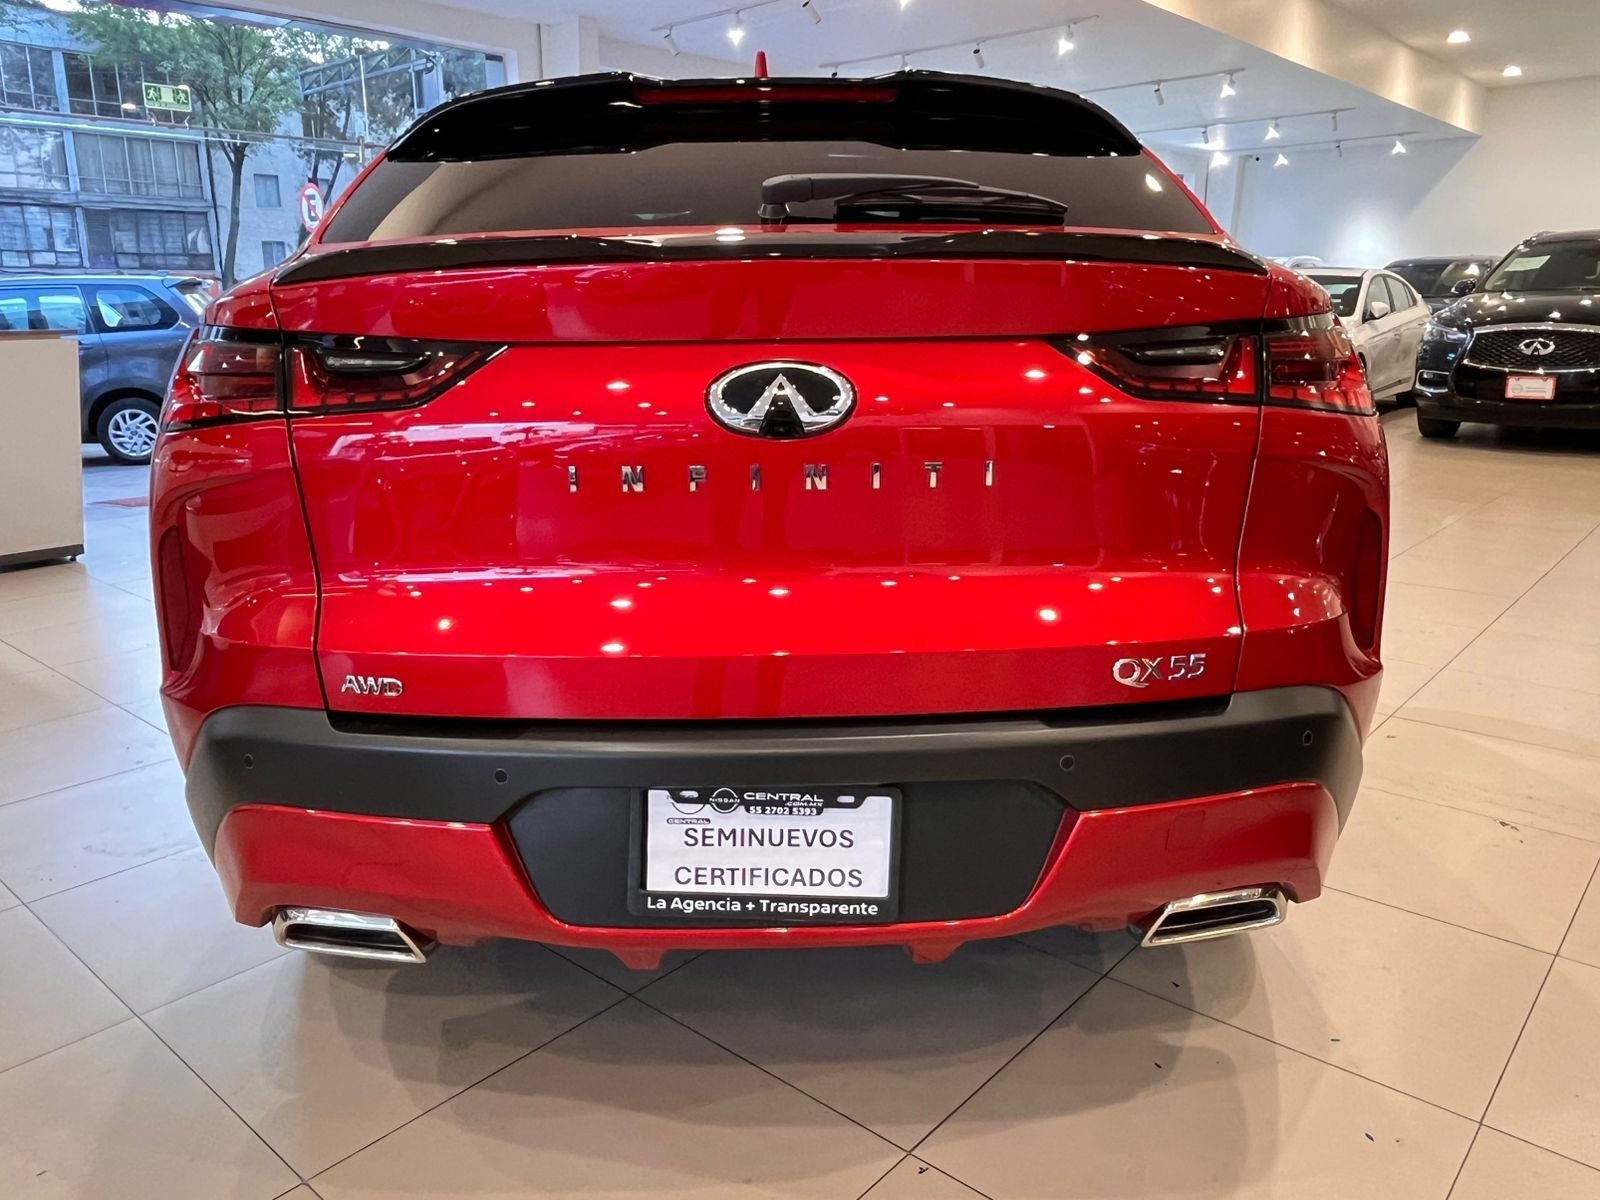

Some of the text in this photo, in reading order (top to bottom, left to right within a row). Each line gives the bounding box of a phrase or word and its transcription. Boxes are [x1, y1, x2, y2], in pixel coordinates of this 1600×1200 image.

[341, 675, 403, 697] AWD
[743, 792, 824, 802] CENTRAL
[749, 806, 817, 816] 55 2702 5393
[684, 828, 854, 848] SEMINUEVOS
[674, 866, 863, 887] CERTIFICADOS
[647, 897, 879, 916] La Agencia + Transparente
